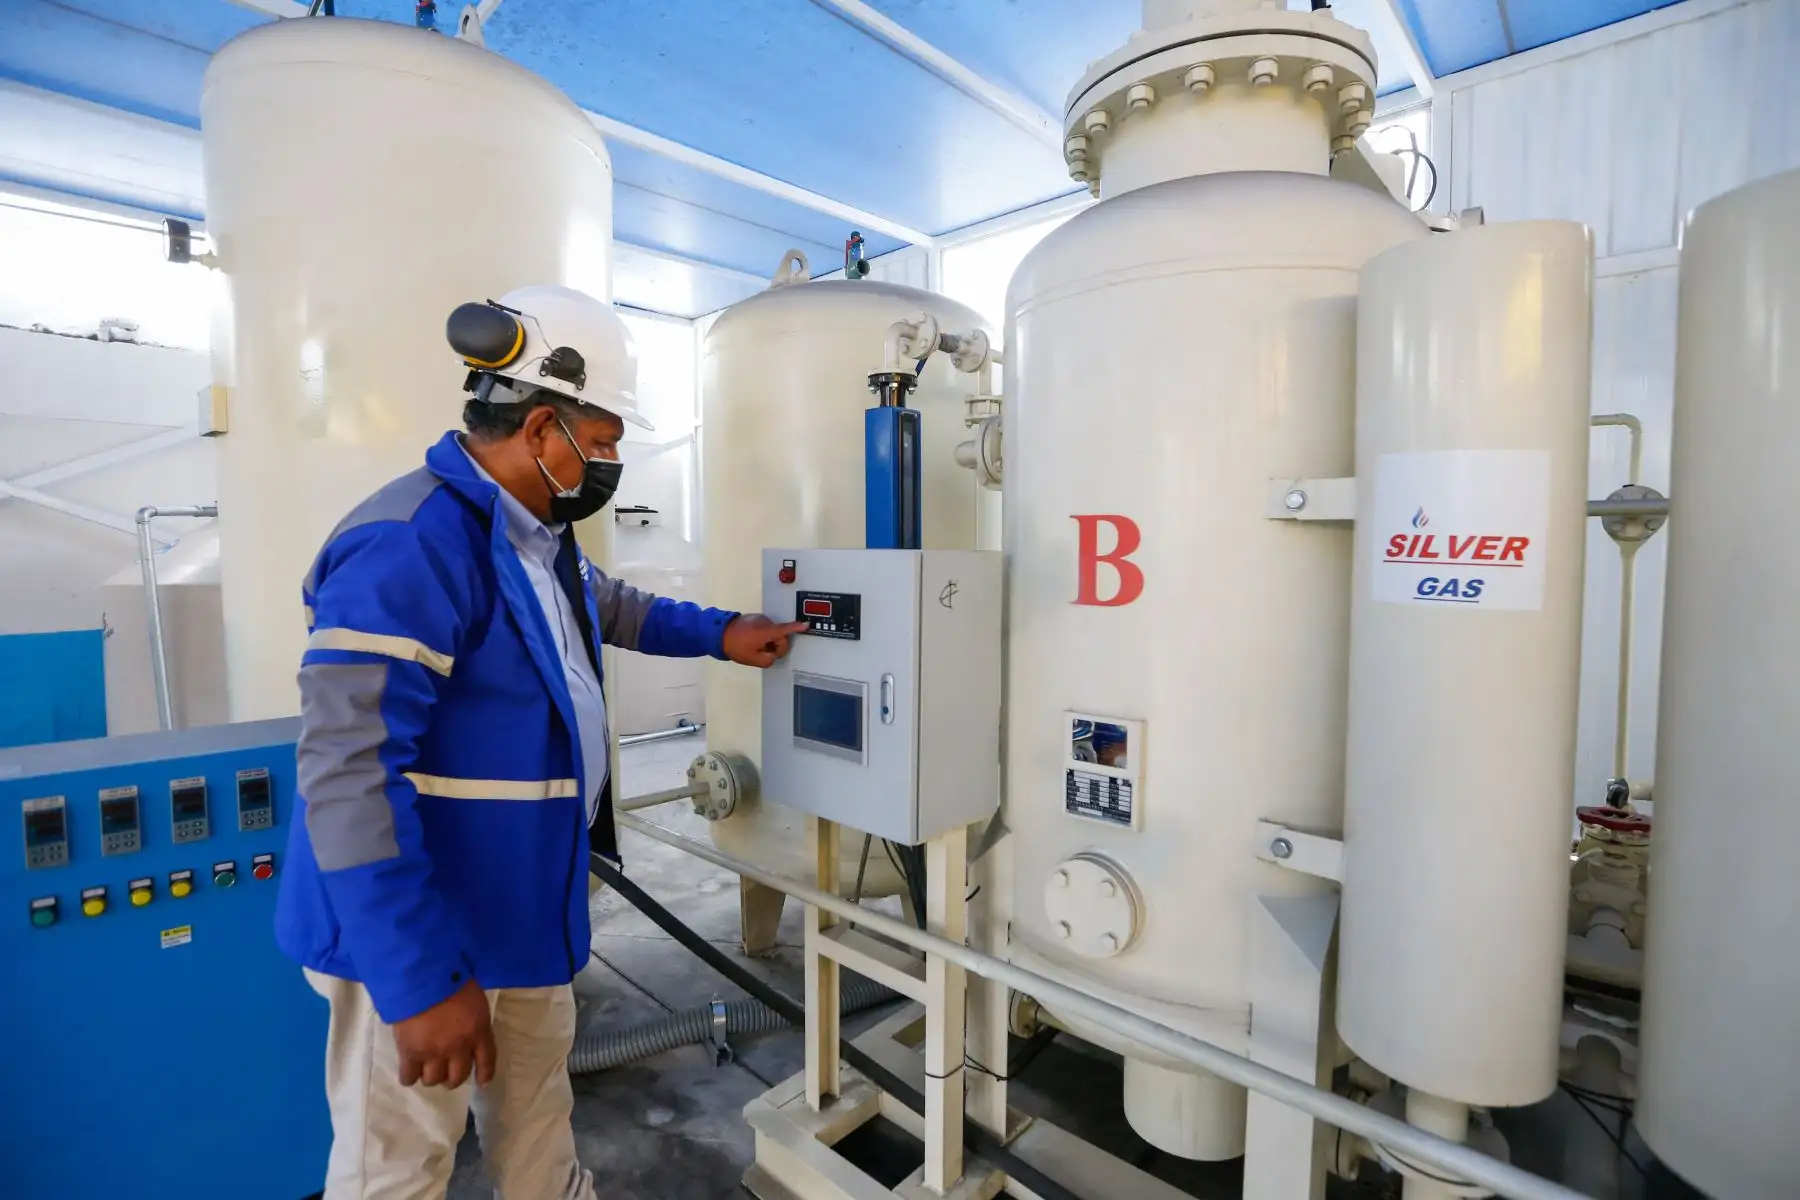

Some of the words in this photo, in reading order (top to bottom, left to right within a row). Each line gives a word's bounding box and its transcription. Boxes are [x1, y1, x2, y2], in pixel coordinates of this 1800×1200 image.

[1069, 514, 1144, 606] B
[1385, 533, 1530, 561] SILVER
[1416, 576, 1485, 598] GAS
